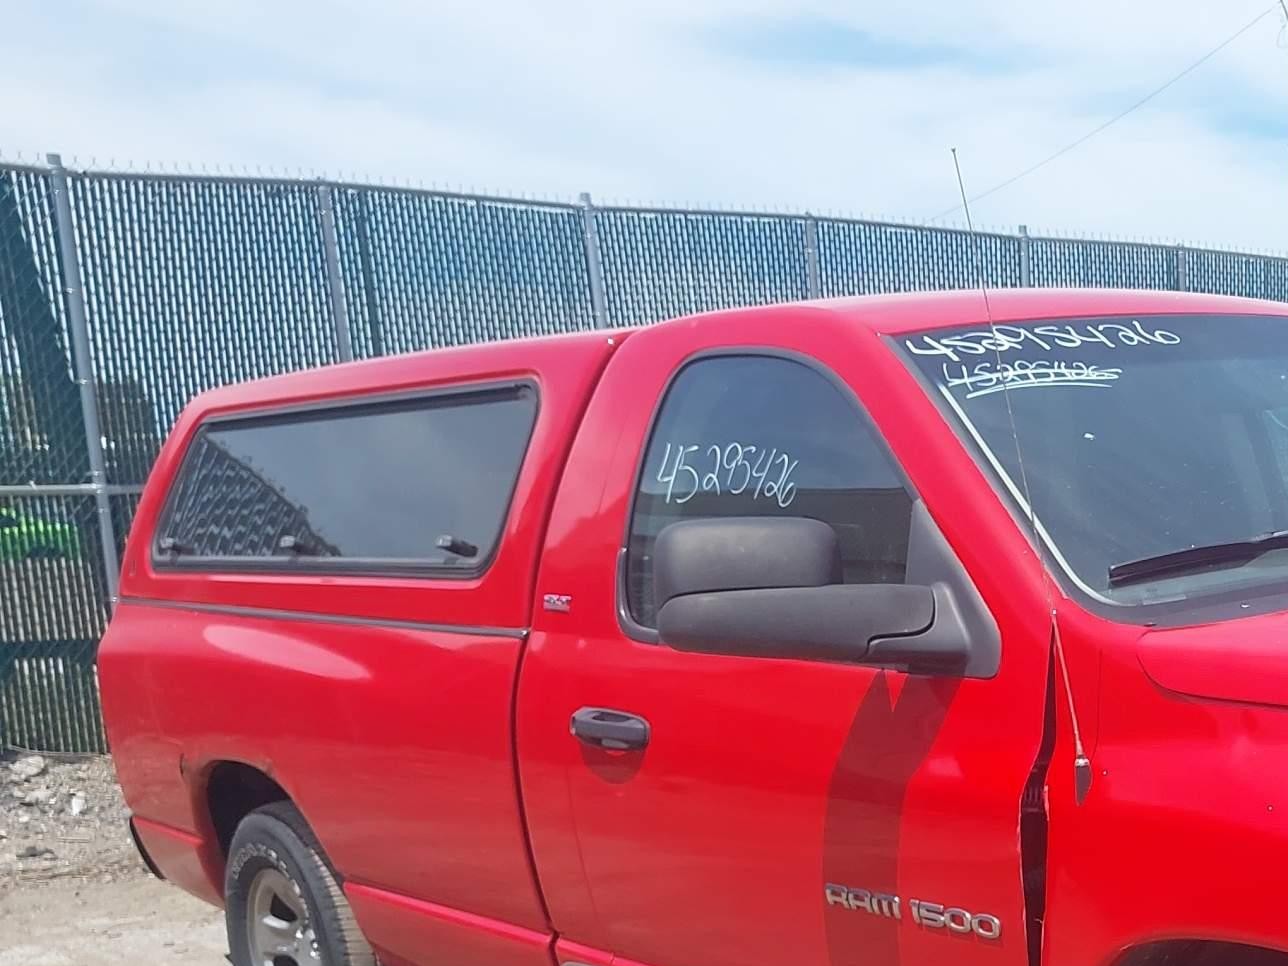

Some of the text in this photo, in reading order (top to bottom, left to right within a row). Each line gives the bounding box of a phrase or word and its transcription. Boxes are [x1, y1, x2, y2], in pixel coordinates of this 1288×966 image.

[905, 320, 1181, 362] 45295426
[655, 442, 800, 508] 45295426
[825, 883, 1001, 940] RAM 1500
